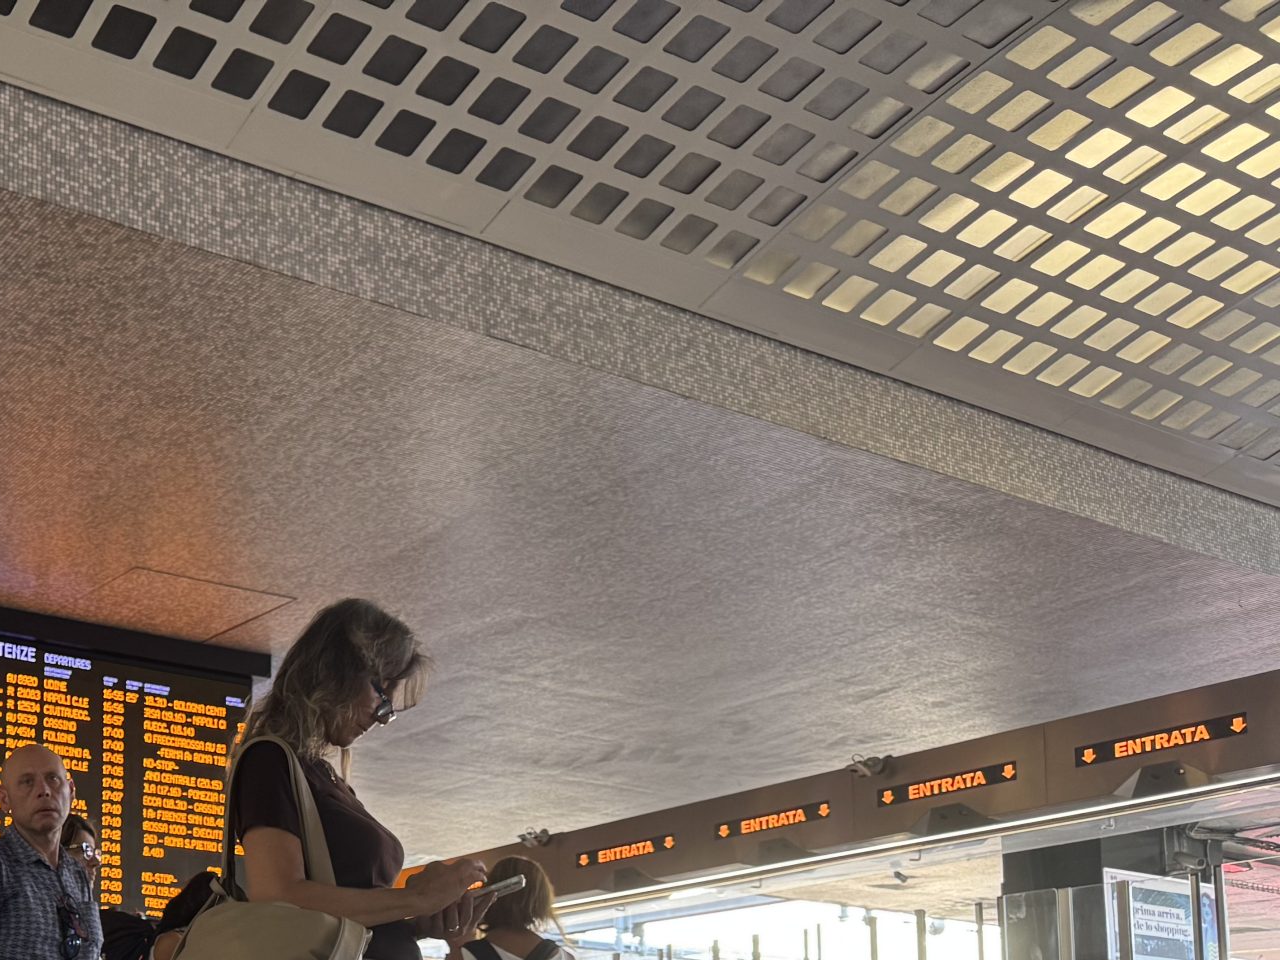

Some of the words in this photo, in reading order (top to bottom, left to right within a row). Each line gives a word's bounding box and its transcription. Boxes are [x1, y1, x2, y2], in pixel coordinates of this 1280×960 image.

[44, 652, 92, 671] DEPARTURES
[44, 692, 70, 705] NAPOLI
[43, 717, 76, 731] CASSINO
[193, 716, 218, 728] NAPOLI
[43, 730, 75, 744] FOLIGNO
[103, 727, 124, 738] 17:00
[103, 740, 124, 751] 17:00
[1114, 725, 1210, 758] ENTRATA
[161, 773, 196, 787] CENTRALE
[908, 771, 987, 800] ENTRATA
[740, 809, 806, 834] ENTRATA
[598, 841, 655, 863] ENTRATA
[101, 867, 122, 878] 17:20
[101, 880, 122, 891] 17:20
[1157, 908, 1183, 921] arriva.
